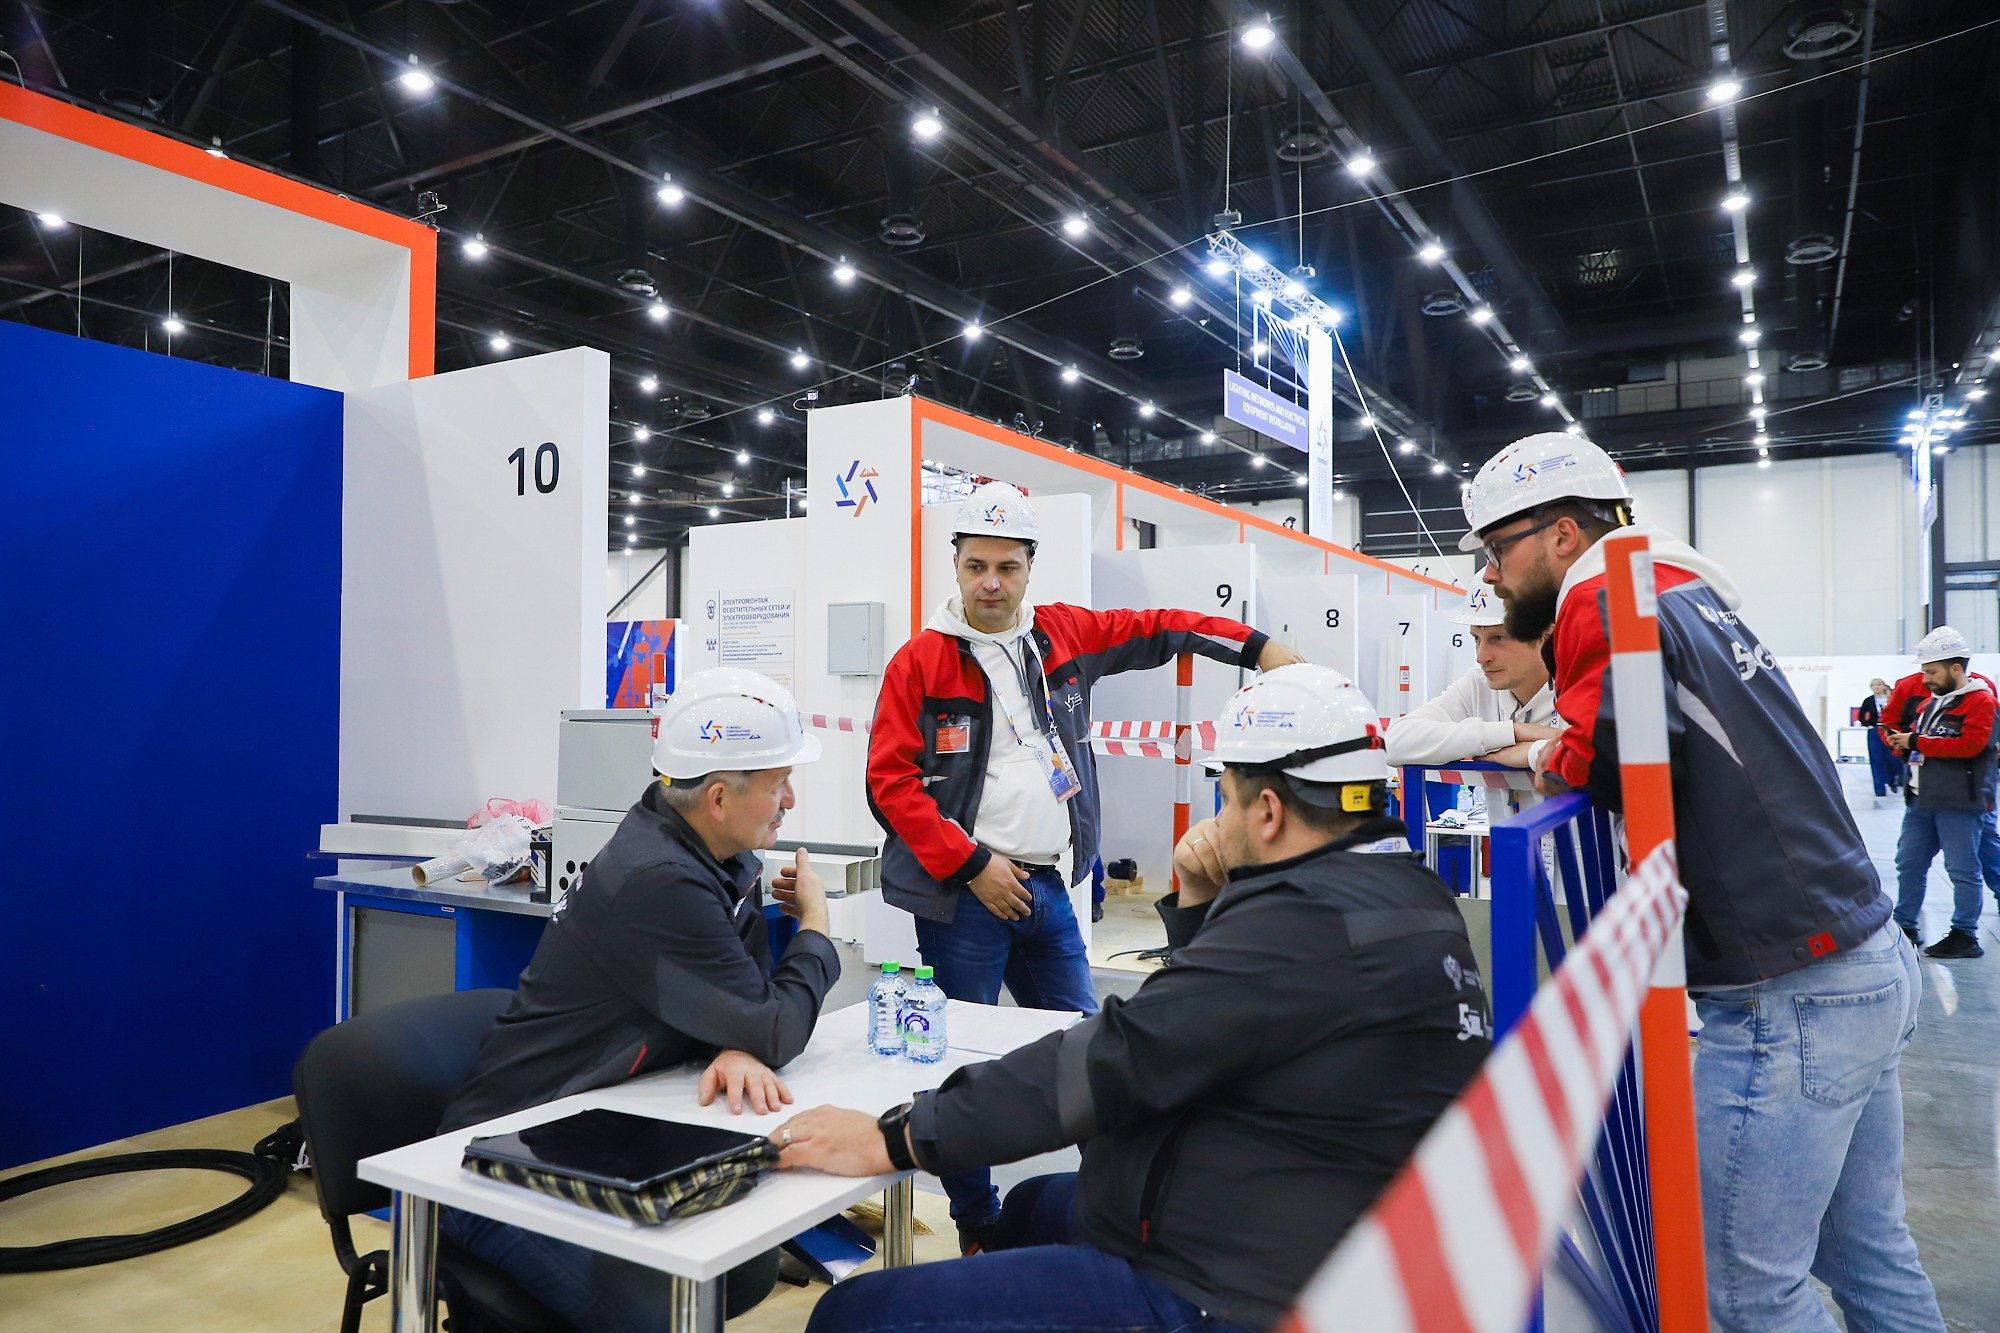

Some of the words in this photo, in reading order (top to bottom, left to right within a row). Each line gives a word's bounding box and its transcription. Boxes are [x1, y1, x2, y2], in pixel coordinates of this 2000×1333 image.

[1229, 381, 1250, 401] LIGHTING
[1251, 391, 1275, 412] NETWORKS
[1276, 404, 1284, 417] AND
[1285, 408, 1306, 427] ELECTRICAL
[1242, 401, 1268, 422] EQUIPMENT
[1269, 414, 1296, 435] INSTALLATION
[507, 442, 559, 496] 10
[722, 598, 769, 606] ЭЛЕКТРОМОНТАЖ
[1216, 583, 1233, 608] 9
[722, 605, 768, 614] ОСВЕТИТЕЛЬНЫХ
[768, 603, 785, 612] СЕТЕЙ
[722, 612, 790, 622] ЭЛЕКТРООБОРУДОВАНИЯ
[1326, 608, 1340, 628] 8
[1398, 622, 1410, 636] 7
[1452, 633, 1462, 647] 6
